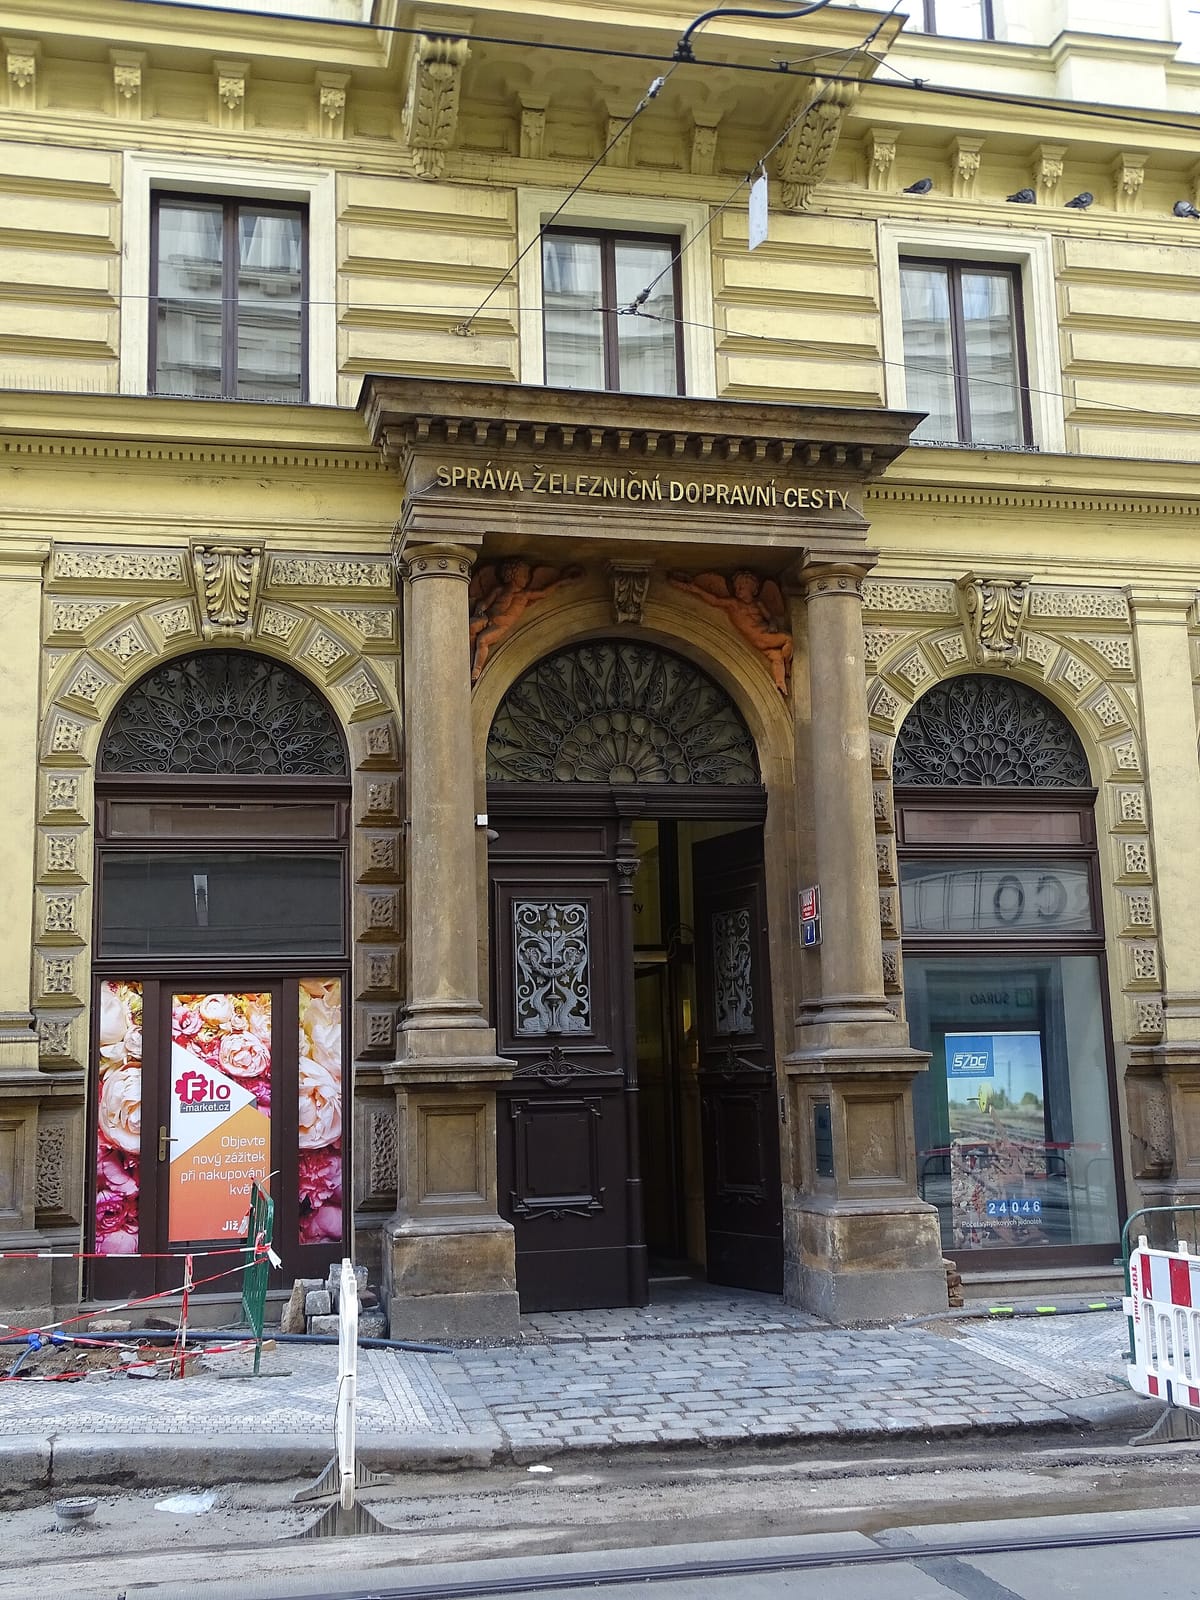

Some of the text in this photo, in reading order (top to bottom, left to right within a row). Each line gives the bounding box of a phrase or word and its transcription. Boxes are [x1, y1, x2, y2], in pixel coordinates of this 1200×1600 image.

[436, 461, 849, 510] SPRÁVA ŽELEZNIČNÍ DOPRAVNÍ CESTY
[187, 1079, 231, 1100] Flo
[183, 1103, 230, 1112] -market.cz
[221, 1136, 266, 1149] Objevte
[193, 1150, 265, 1166] nový zážitek
[181, 1166, 266, 1184] při nakupování
[222, 1220, 239, 1231] Již
